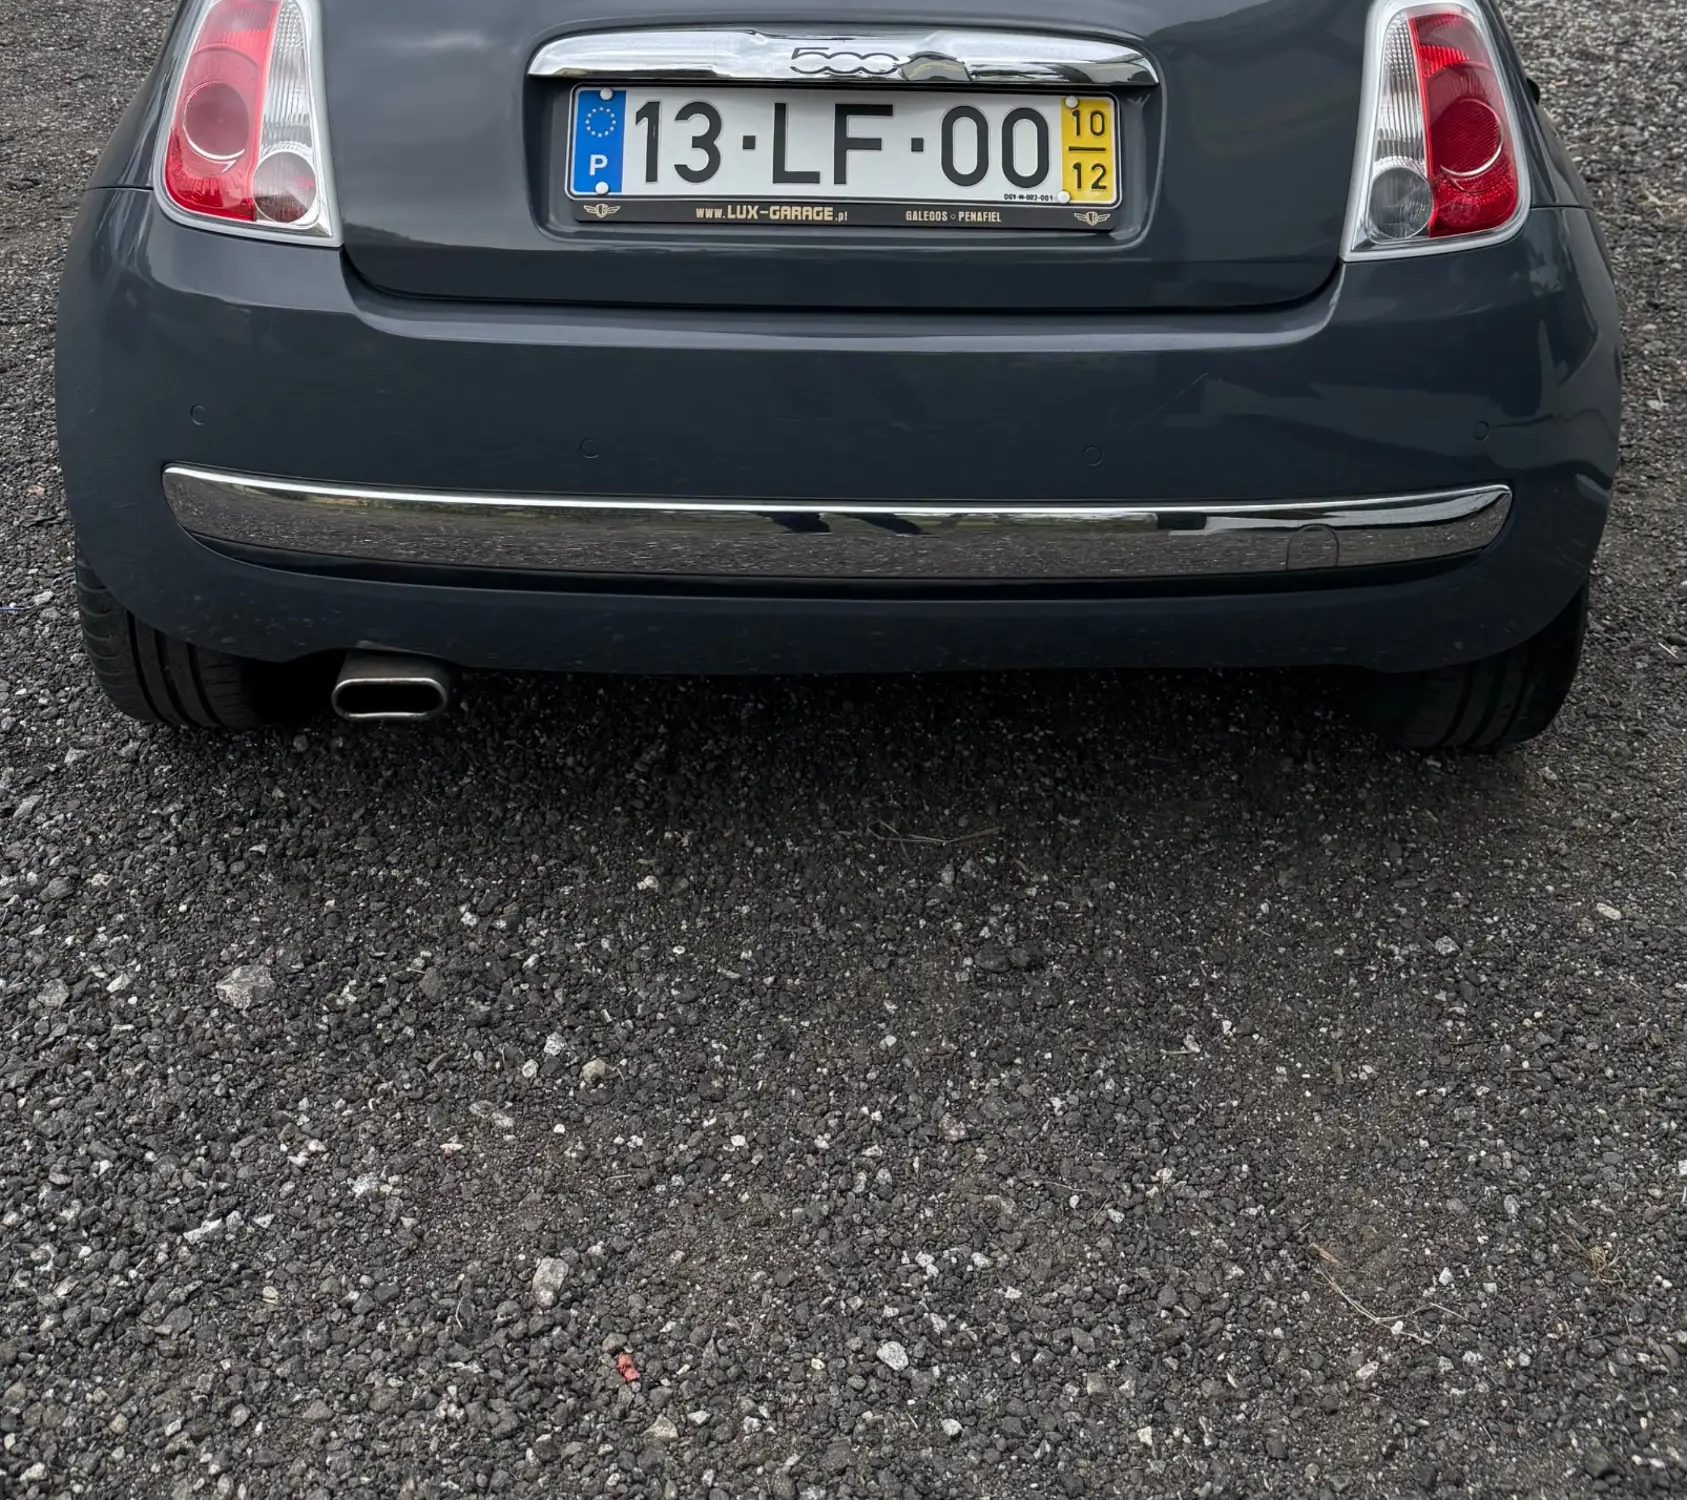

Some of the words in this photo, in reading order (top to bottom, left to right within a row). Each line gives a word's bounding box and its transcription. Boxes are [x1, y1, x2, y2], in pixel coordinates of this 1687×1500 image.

[790, 47, 901, 75] 500
[1072, 110, 1105, 137] 10
[589, 154, 608, 176] P
[1072, 163, 1107, 190] 12
[905, 210, 948, 222] GALEGOS
[958, 211, 1002, 223] PENAFIEL
